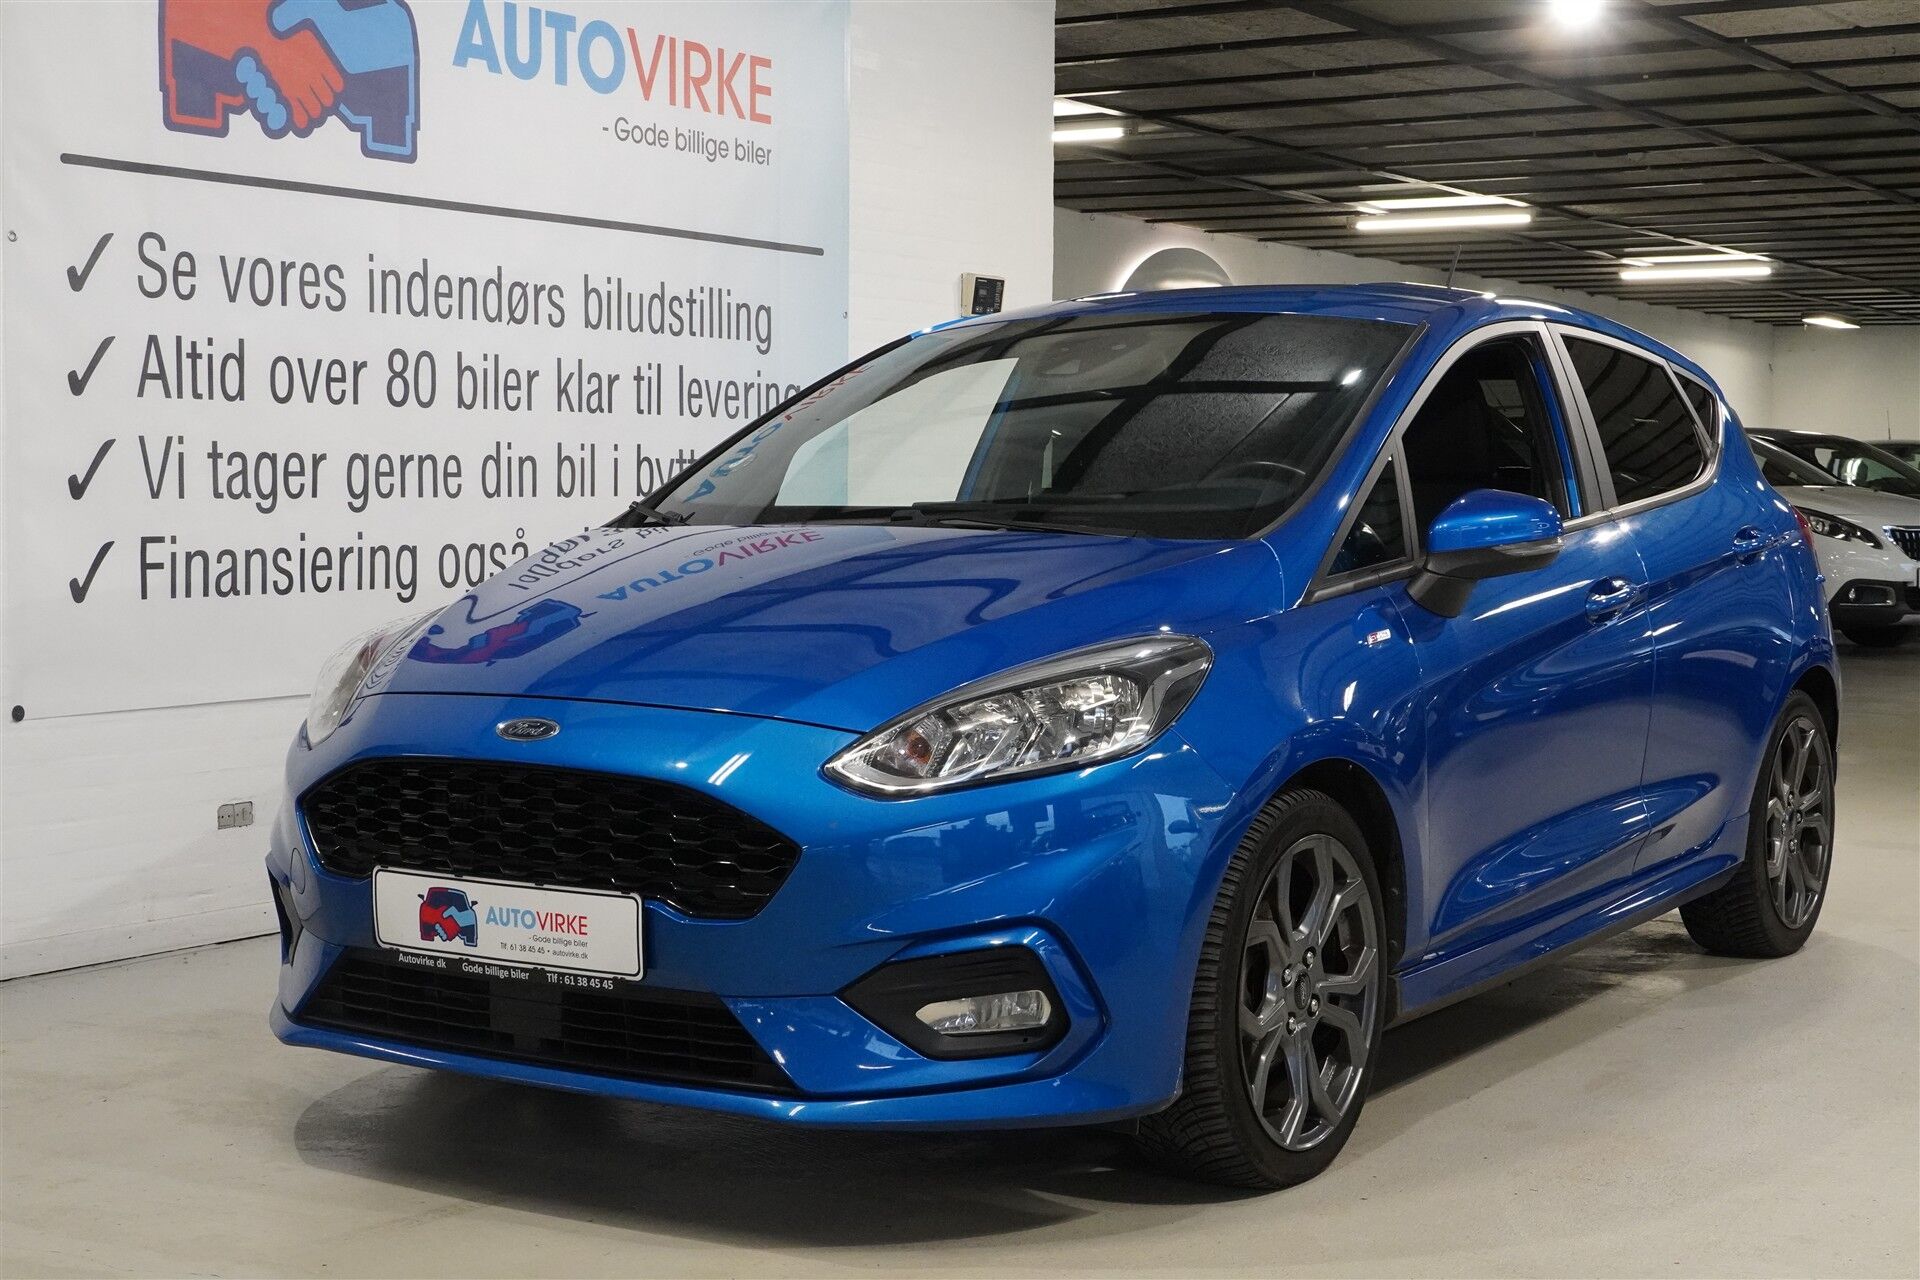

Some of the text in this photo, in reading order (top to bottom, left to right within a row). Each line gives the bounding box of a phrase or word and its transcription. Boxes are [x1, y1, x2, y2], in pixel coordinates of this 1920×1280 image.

[452, 0, 772, 124] AUTOVIRKE
[615, 116, 669, 148] Gode
[675, 127, 729, 163] billige
[735, 138, 772, 166] biler
[137, 231, 772, 356] Se vores indendørs biludstilling
[137, 334, 244, 403] Altid
[270, 355, 367, 407] over
[387, 348, 436, 409] 80
[457, 351, 540, 415] biler
[557, 357, 619, 416] klar
[634, 361, 662, 416] til
[139, 436, 184, 500] Vi
[207, 440, 328, 515] tager
[347, 452, 461, 515] gerne
[482, 440, 537, 499] din
[557, 442, 595, 499] bil
[613, 443, 618, 497] i
[140, 535, 417, 604] Finansiering
[486, 906, 588, 936] AUTOVIRKE
[519, 944, 526, 952] 38
[533, 935, 551, 943] Gode
[552, 937, 572, 947] billige
[573, 939, 588, 948] biler
[399, 953, 434, 967] Autovirke
[436, 958, 447, 968] dk
[462, 963, 483, 974] Gode
[484, 965, 509, 979] billige
[510, 969, 530, 980] biler
[564, 975, 575, 985] 61
[577, 977, 588, 987] 38
[590, 978, 601, 988] 45
[602, 980, 613, 990] 45
